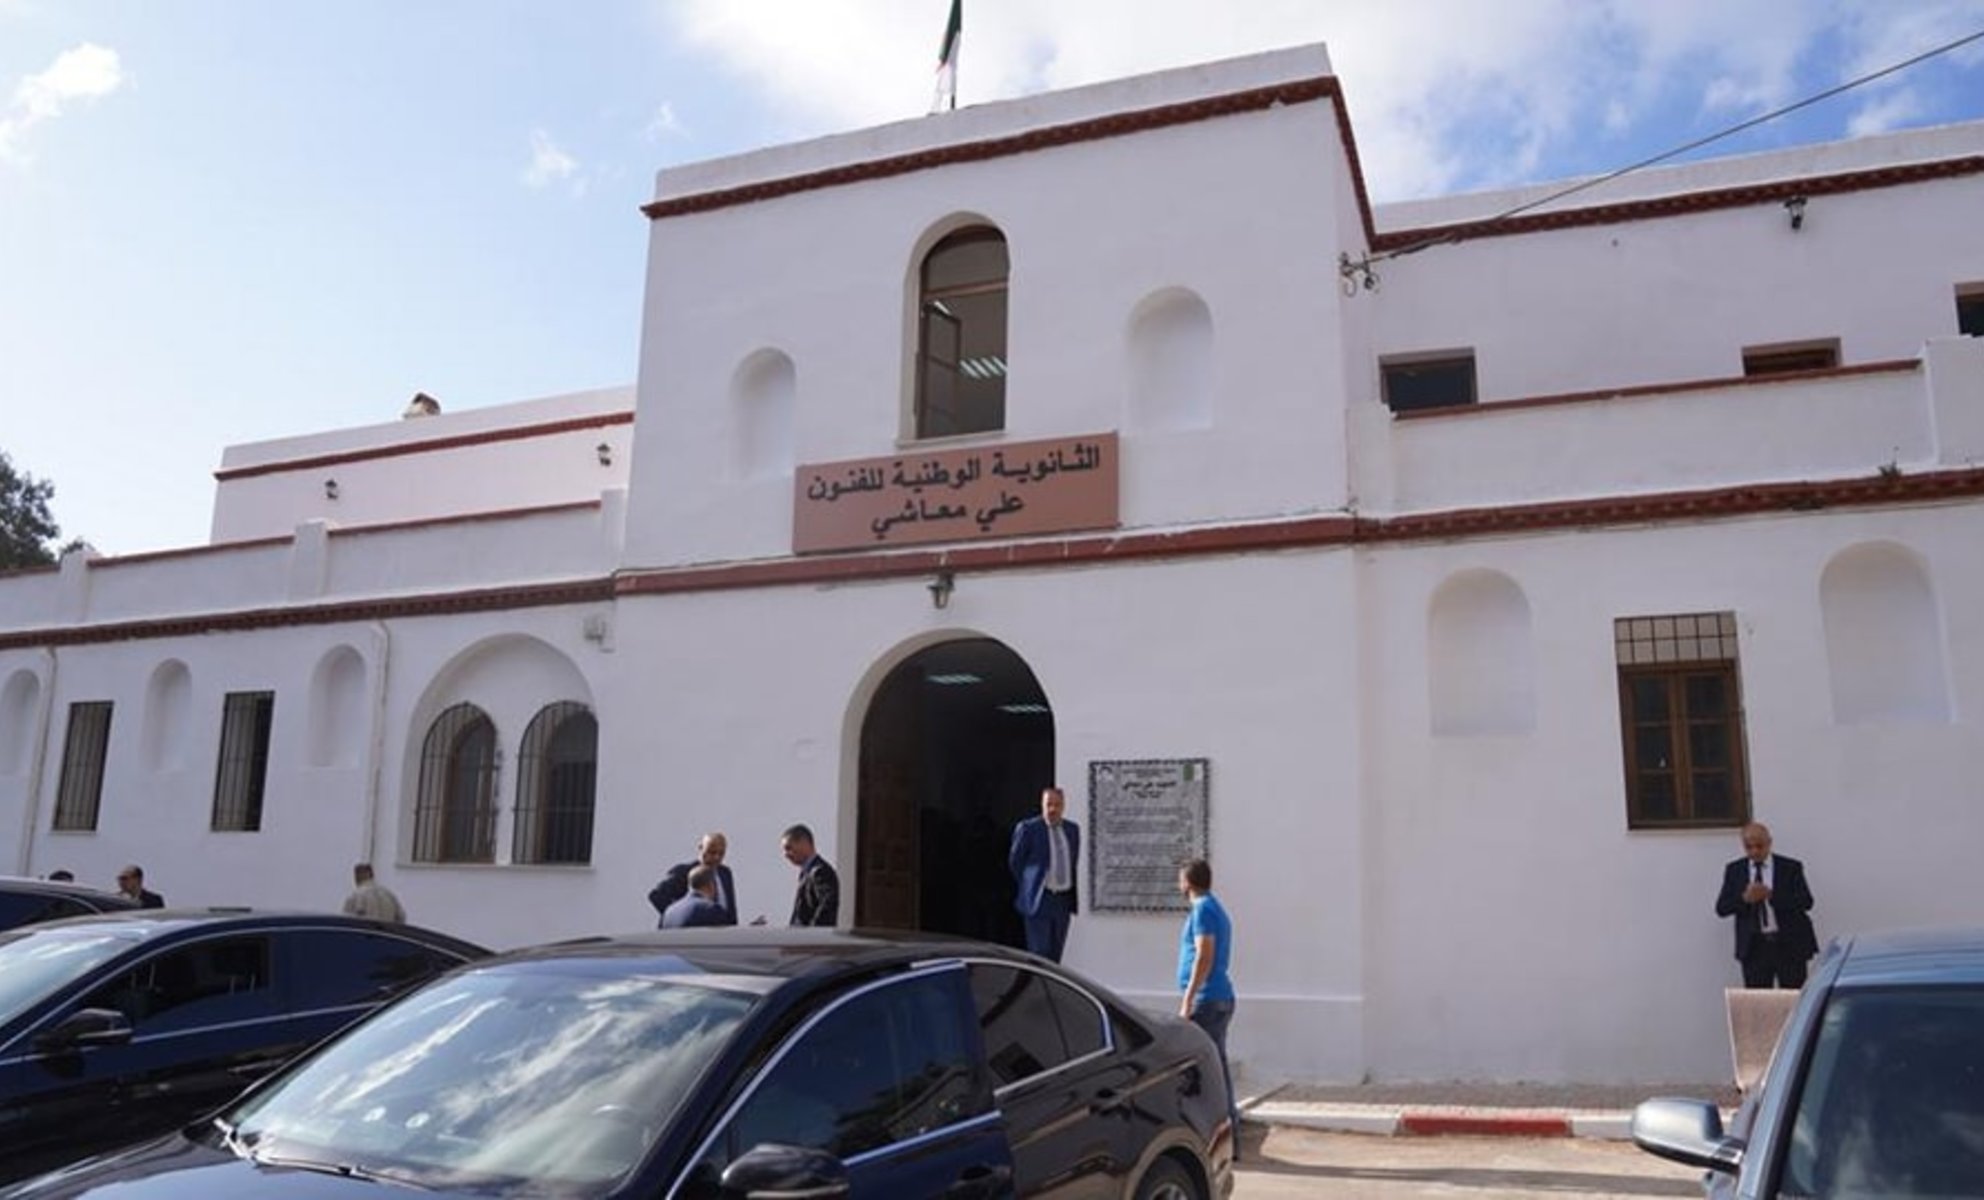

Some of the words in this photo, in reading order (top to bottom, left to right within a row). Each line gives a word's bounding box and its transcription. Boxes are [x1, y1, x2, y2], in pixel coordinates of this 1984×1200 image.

[807, 467, 885, 501] للفنون
[891, 458, 982, 494] الوطنية
[991, 443, 1101, 484] الثانوية
[871, 499, 968, 540] معاشي
[975, 490, 1025, 532] علي
